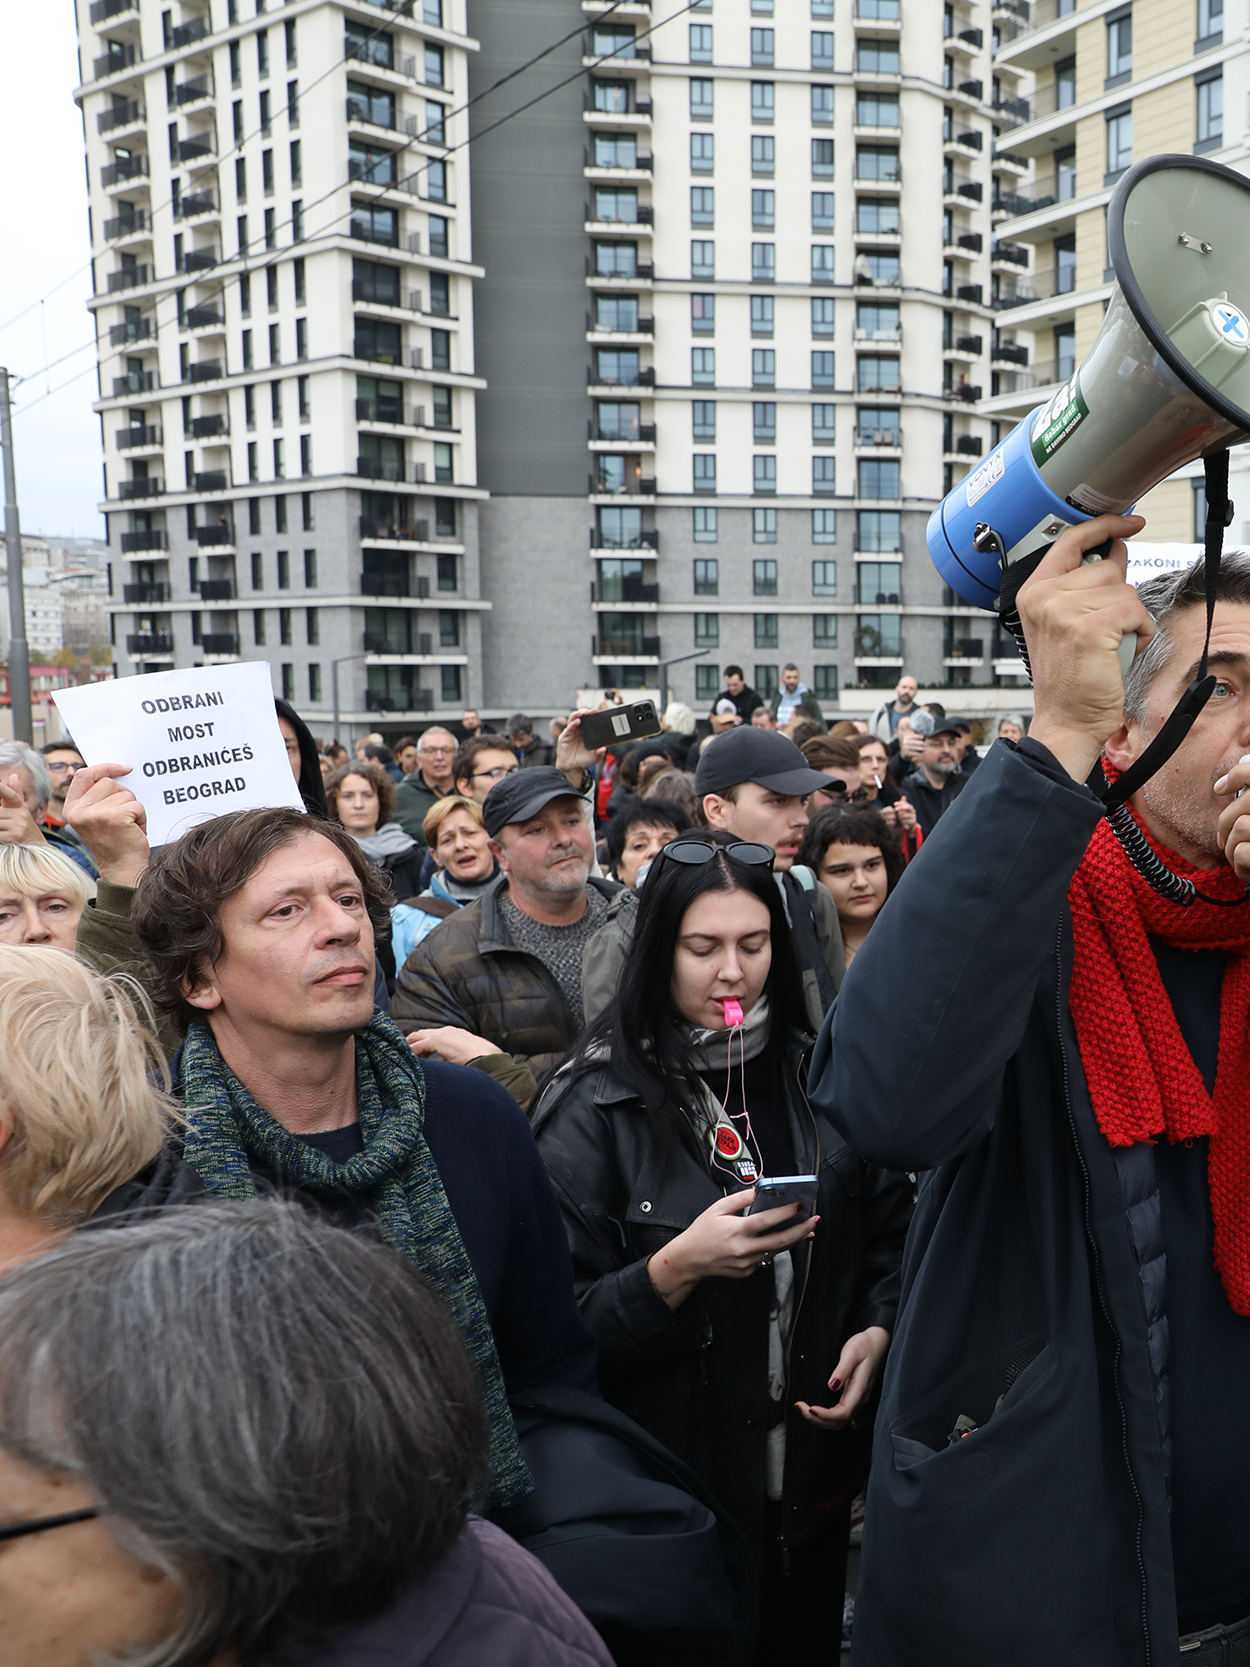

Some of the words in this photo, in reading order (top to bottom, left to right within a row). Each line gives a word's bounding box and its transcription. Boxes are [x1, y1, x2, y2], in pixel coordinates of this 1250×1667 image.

[1044, 421, 1063, 442] dobar
[1062, 403, 1077, 425] grad
[1051, 430, 1067, 449] DAVIMO
[1065, 412, 1082, 434] BEOGRAD
[969, 450, 1002, 487] VONYX
[1127, 558, 1180, 568] ZAKONI
[141, 691, 225, 715] ODBRANI
[167, 722, 215, 742] MOST
[142, 742, 254, 778] ODBRANIĆEŠ
[163, 776, 247, 805] BEOGRAD
